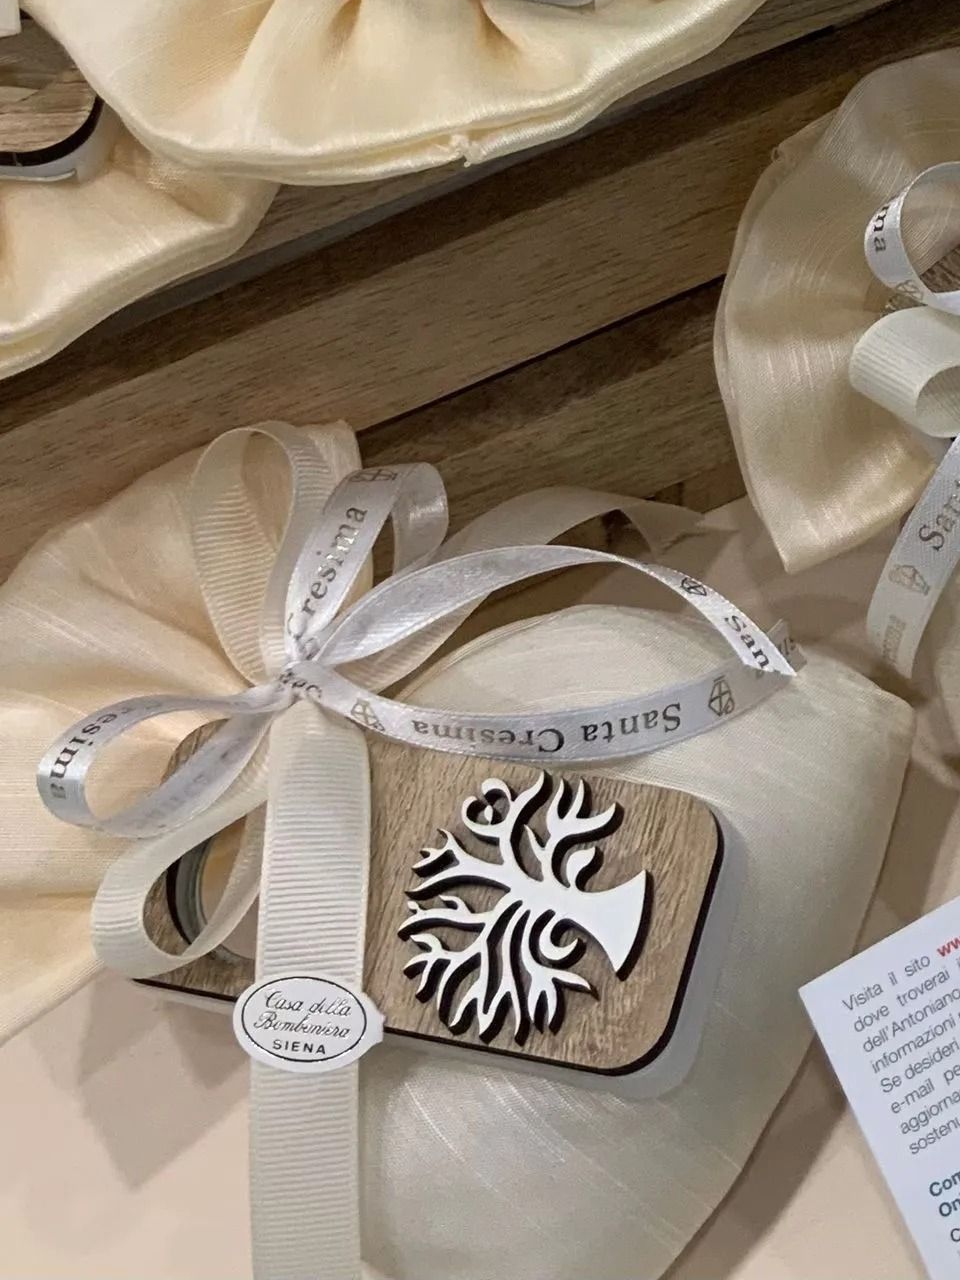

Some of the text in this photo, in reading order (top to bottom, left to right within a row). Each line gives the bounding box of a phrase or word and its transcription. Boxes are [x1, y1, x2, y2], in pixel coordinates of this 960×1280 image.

[287, 504, 368, 643] Cresima
[411, 702, 682, 754] Santa Cresima
[265, 988, 352, 1017] Casa della
[841, 983, 884, 1011] Visita
[887, 971, 898, 986] il
[904, 955, 930, 977] sito
[272, 1038, 327, 1055] SIENA
[869, 1012, 956, 1074] informazioni
[879, 1074, 902, 1094] Se
